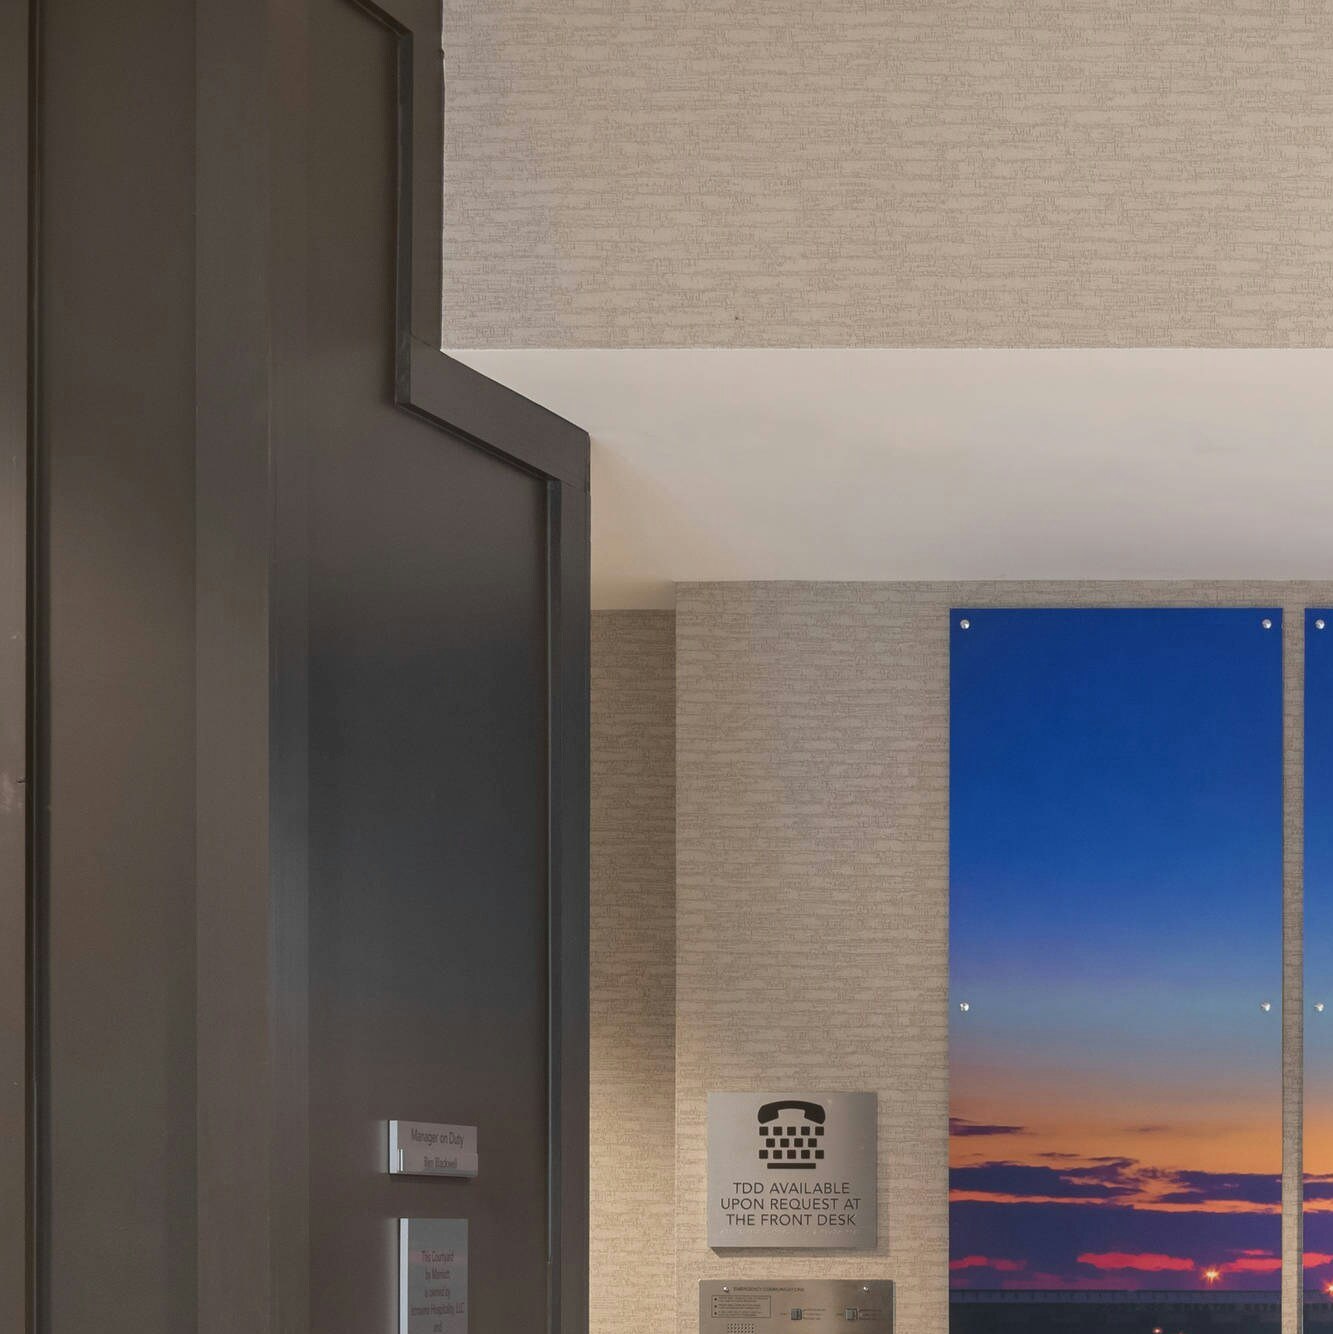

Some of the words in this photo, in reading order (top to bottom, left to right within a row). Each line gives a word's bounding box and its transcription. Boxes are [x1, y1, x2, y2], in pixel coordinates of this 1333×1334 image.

[411, 1128, 439, 1147] Manager
[440, 1134, 448, 1143] on
[449, 1131, 464, 1149] Duty
[733, 1182, 764, 1194] TDD
[769, 1182, 850, 1194] AVAILABLE
[720, 1198, 764, 1210] UPON
[770, 1198, 837, 1212] REQUEST
[843, 1198, 861, 1210] AT
[726, 1213, 755, 1226] THE
[761, 1213, 812, 1226] FRONT
[817, 1213, 856, 1226] DESK
